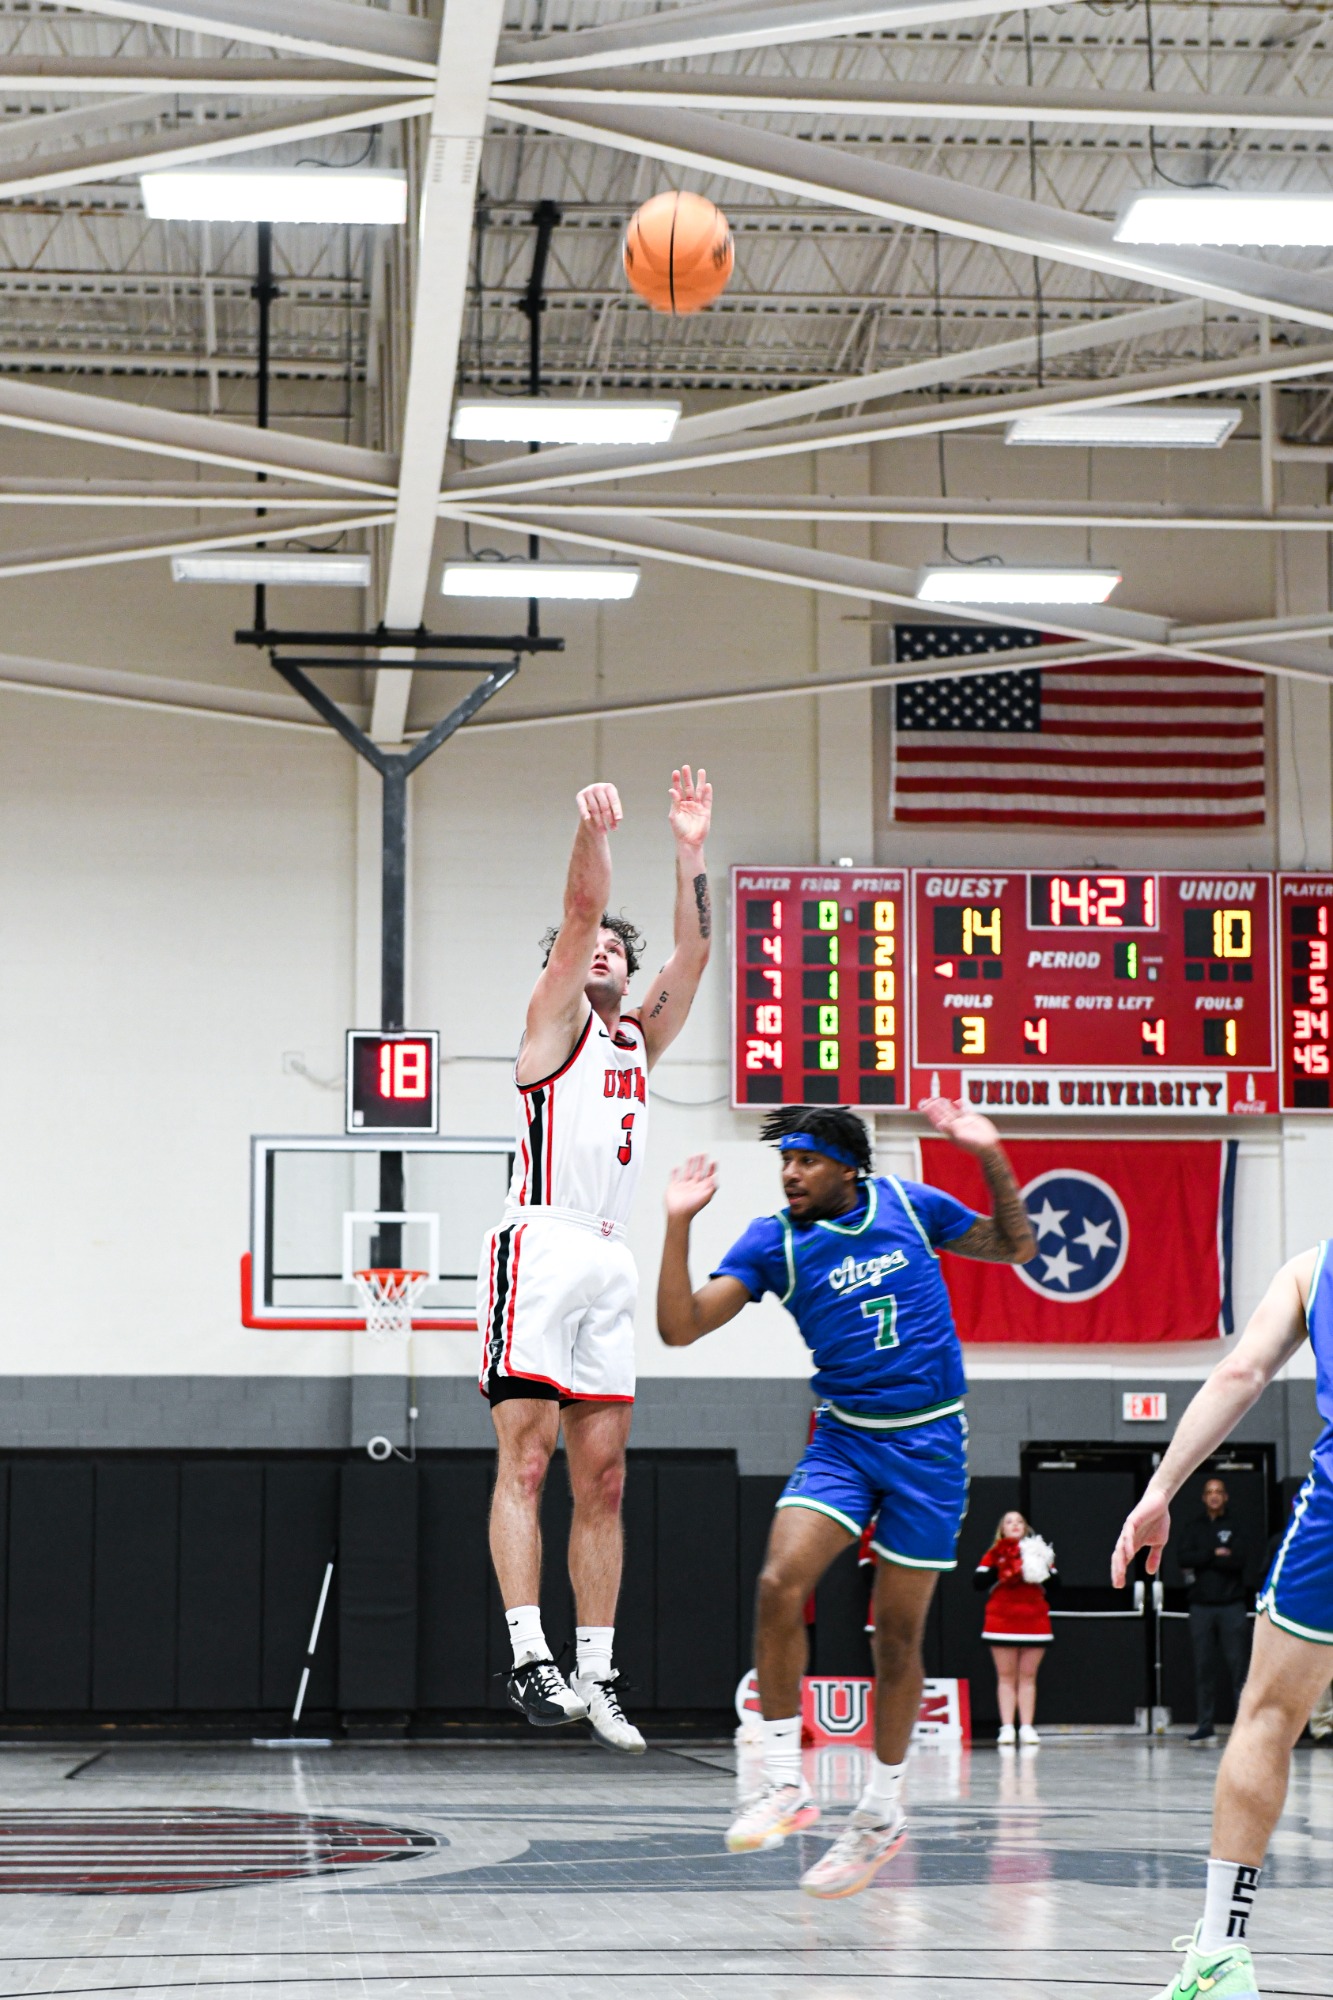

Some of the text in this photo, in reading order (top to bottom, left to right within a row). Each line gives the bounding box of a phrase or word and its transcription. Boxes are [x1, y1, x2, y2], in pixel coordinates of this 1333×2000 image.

[739, 877, 791, 891] PLAYER
[926, 878, 1008, 898] GUEST
[1180, 880, 1257, 901] UNION
[772, 900, 895, 932] 1 0 0
[1050, 877, 1154, 927] 14:21
[962, 906, 1001, 956] 14
[1213, 909, 1252, 959] 10
[1318, 906, 1328, 936] 1
[762, 935, 895, 967] 4 1 2
[1027, 951, 1101, 969] PERIOD
[1127, 942, 1138, 980] 1
[1308, 940, 1329, 970] 3
[762, 969, 895, 1001] 7 1 0
[1309, 975, 1329, 1005] 5
[944, 994, 993, 1009] FOULS
[1033, 995, 1154, 1011] TIME OUTS LEFT
[1195, 996, 1244, 1011] FOULS
[756, 1004, 895, 1036] 10 0 0
[961, 1016, 985, 1055] 3
[1023, 1017, 1048, 1055] 4
[1292, 1009, 1330, 1040] 34
[1141, 1018, 1165, 1057] 4
[1225, 1018, 1237, 1057] 1
[380, 1043, 427, 1099] 18
[746, 1039, 896, 1071] 24 0 3
[1292, 1044, 1330, 1075] 45
[967, 1079, 1050, 1106] UNION
[1058, 1079, 1224, 1107] UNIVERSITY
[828, 1249, 909, 1295] Argos
[860, 1294, 900, 1351] 7
[1132, 1395, 1159, 1418] EXIT
[808, 1680, 872, 1737] U
